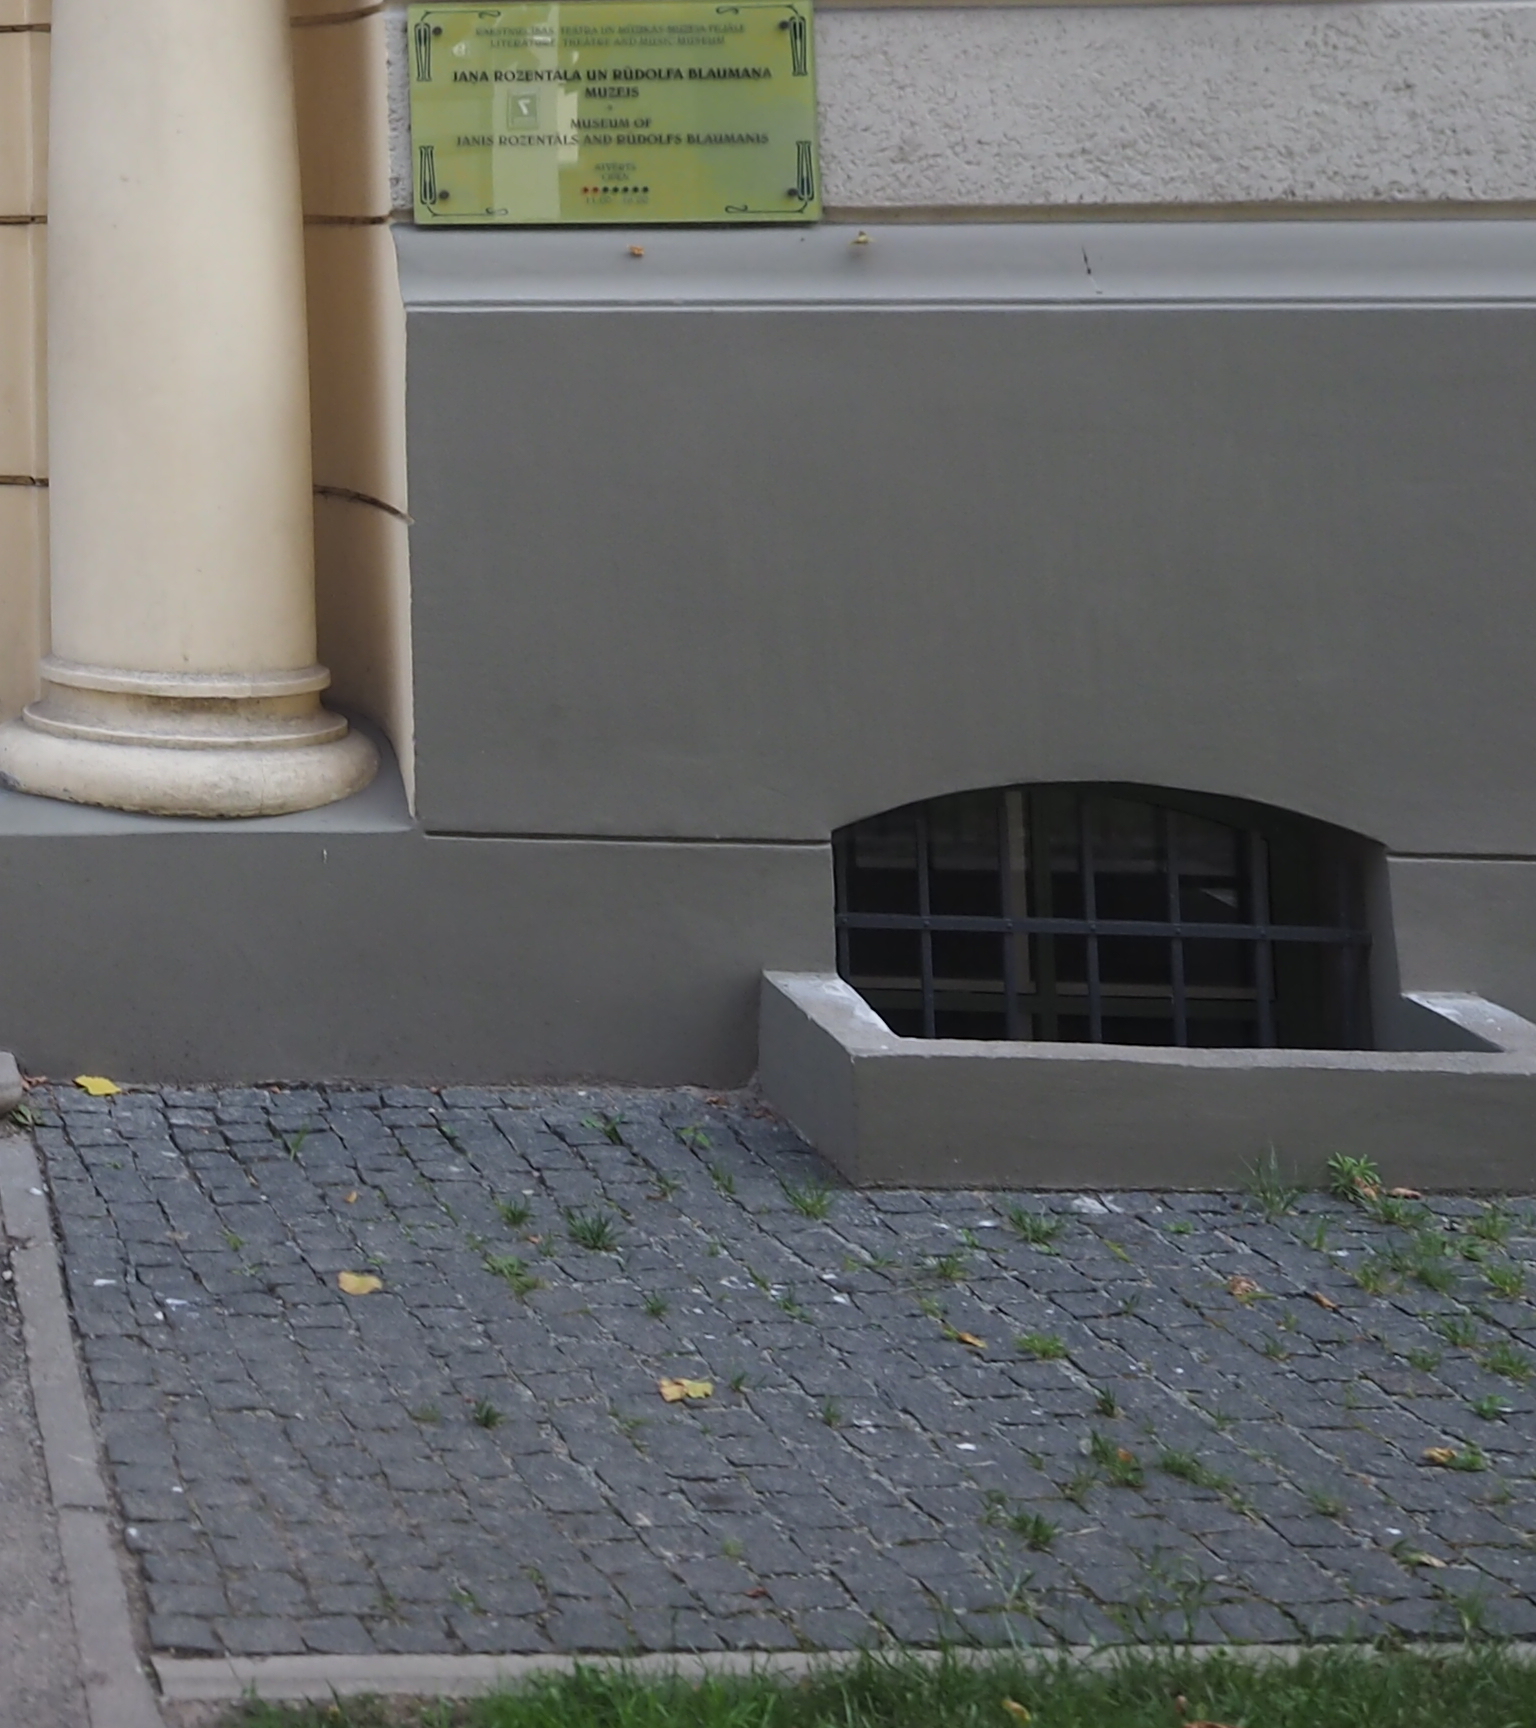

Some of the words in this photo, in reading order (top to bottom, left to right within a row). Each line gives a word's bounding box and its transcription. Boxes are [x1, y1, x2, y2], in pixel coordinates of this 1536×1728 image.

[586, 69, 608, 81] UN
[570, 118, 629, 130] MUSEUM
[633, 118, 653, 129] OF
[583, 134, 613, 146] AND
[686, 133, 769, 146] BLAUMANIS
